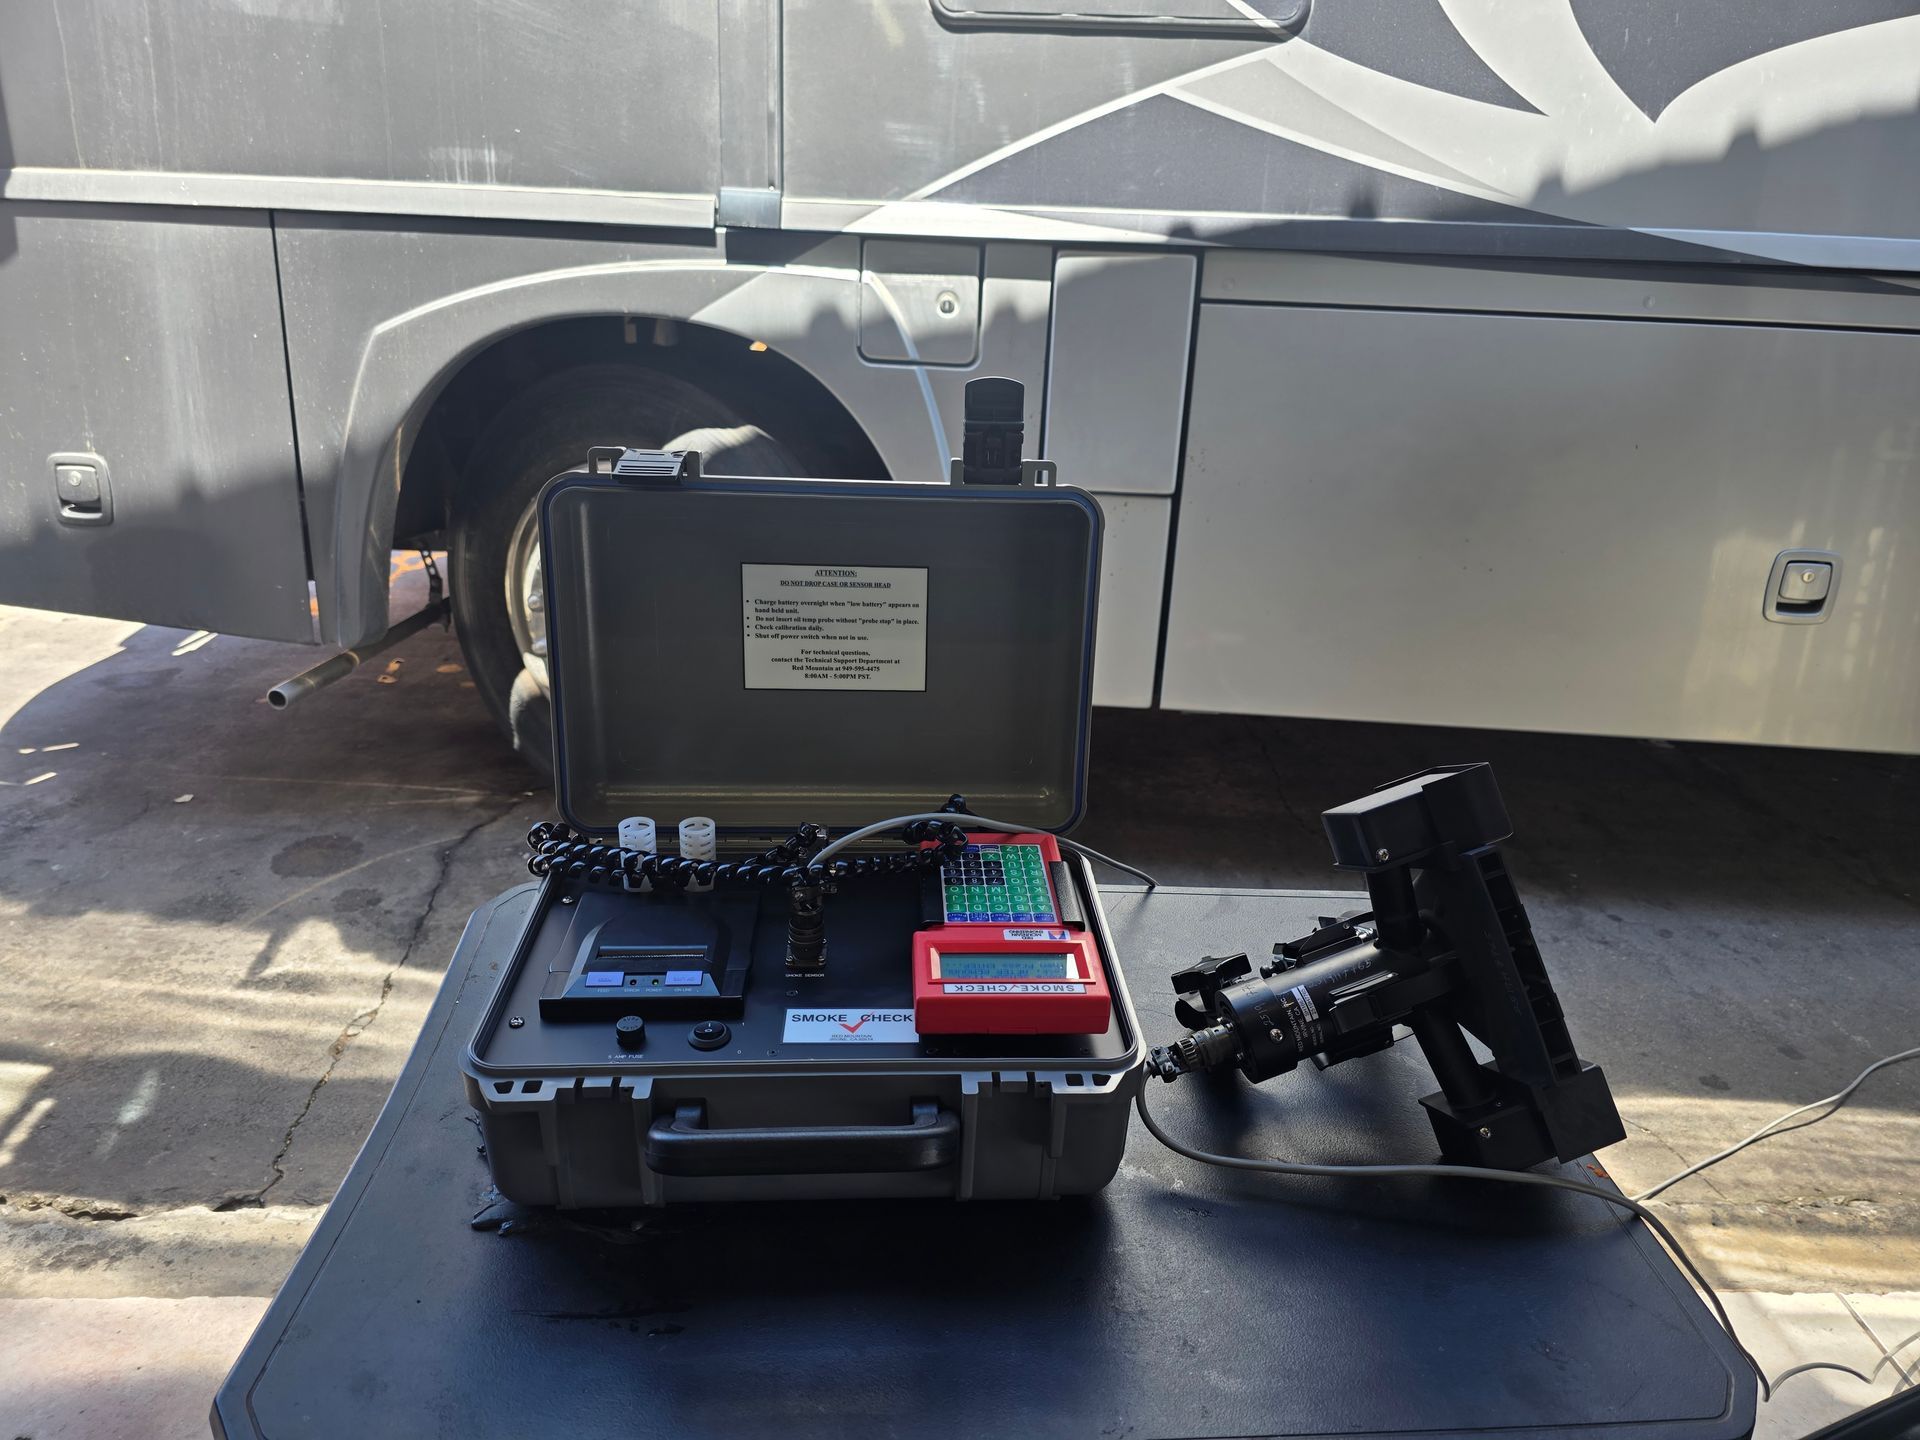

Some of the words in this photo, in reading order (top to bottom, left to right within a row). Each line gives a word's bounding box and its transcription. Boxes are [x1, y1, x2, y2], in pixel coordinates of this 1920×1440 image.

[814, 569, 858, 577] ATTENTION:
[777, 599, 799, 607] battery
[902, 618, 920, 626] place.
[791, 1014, 847, 1022] SMOKE
[860, 1014, 913, 1022] CHECK
